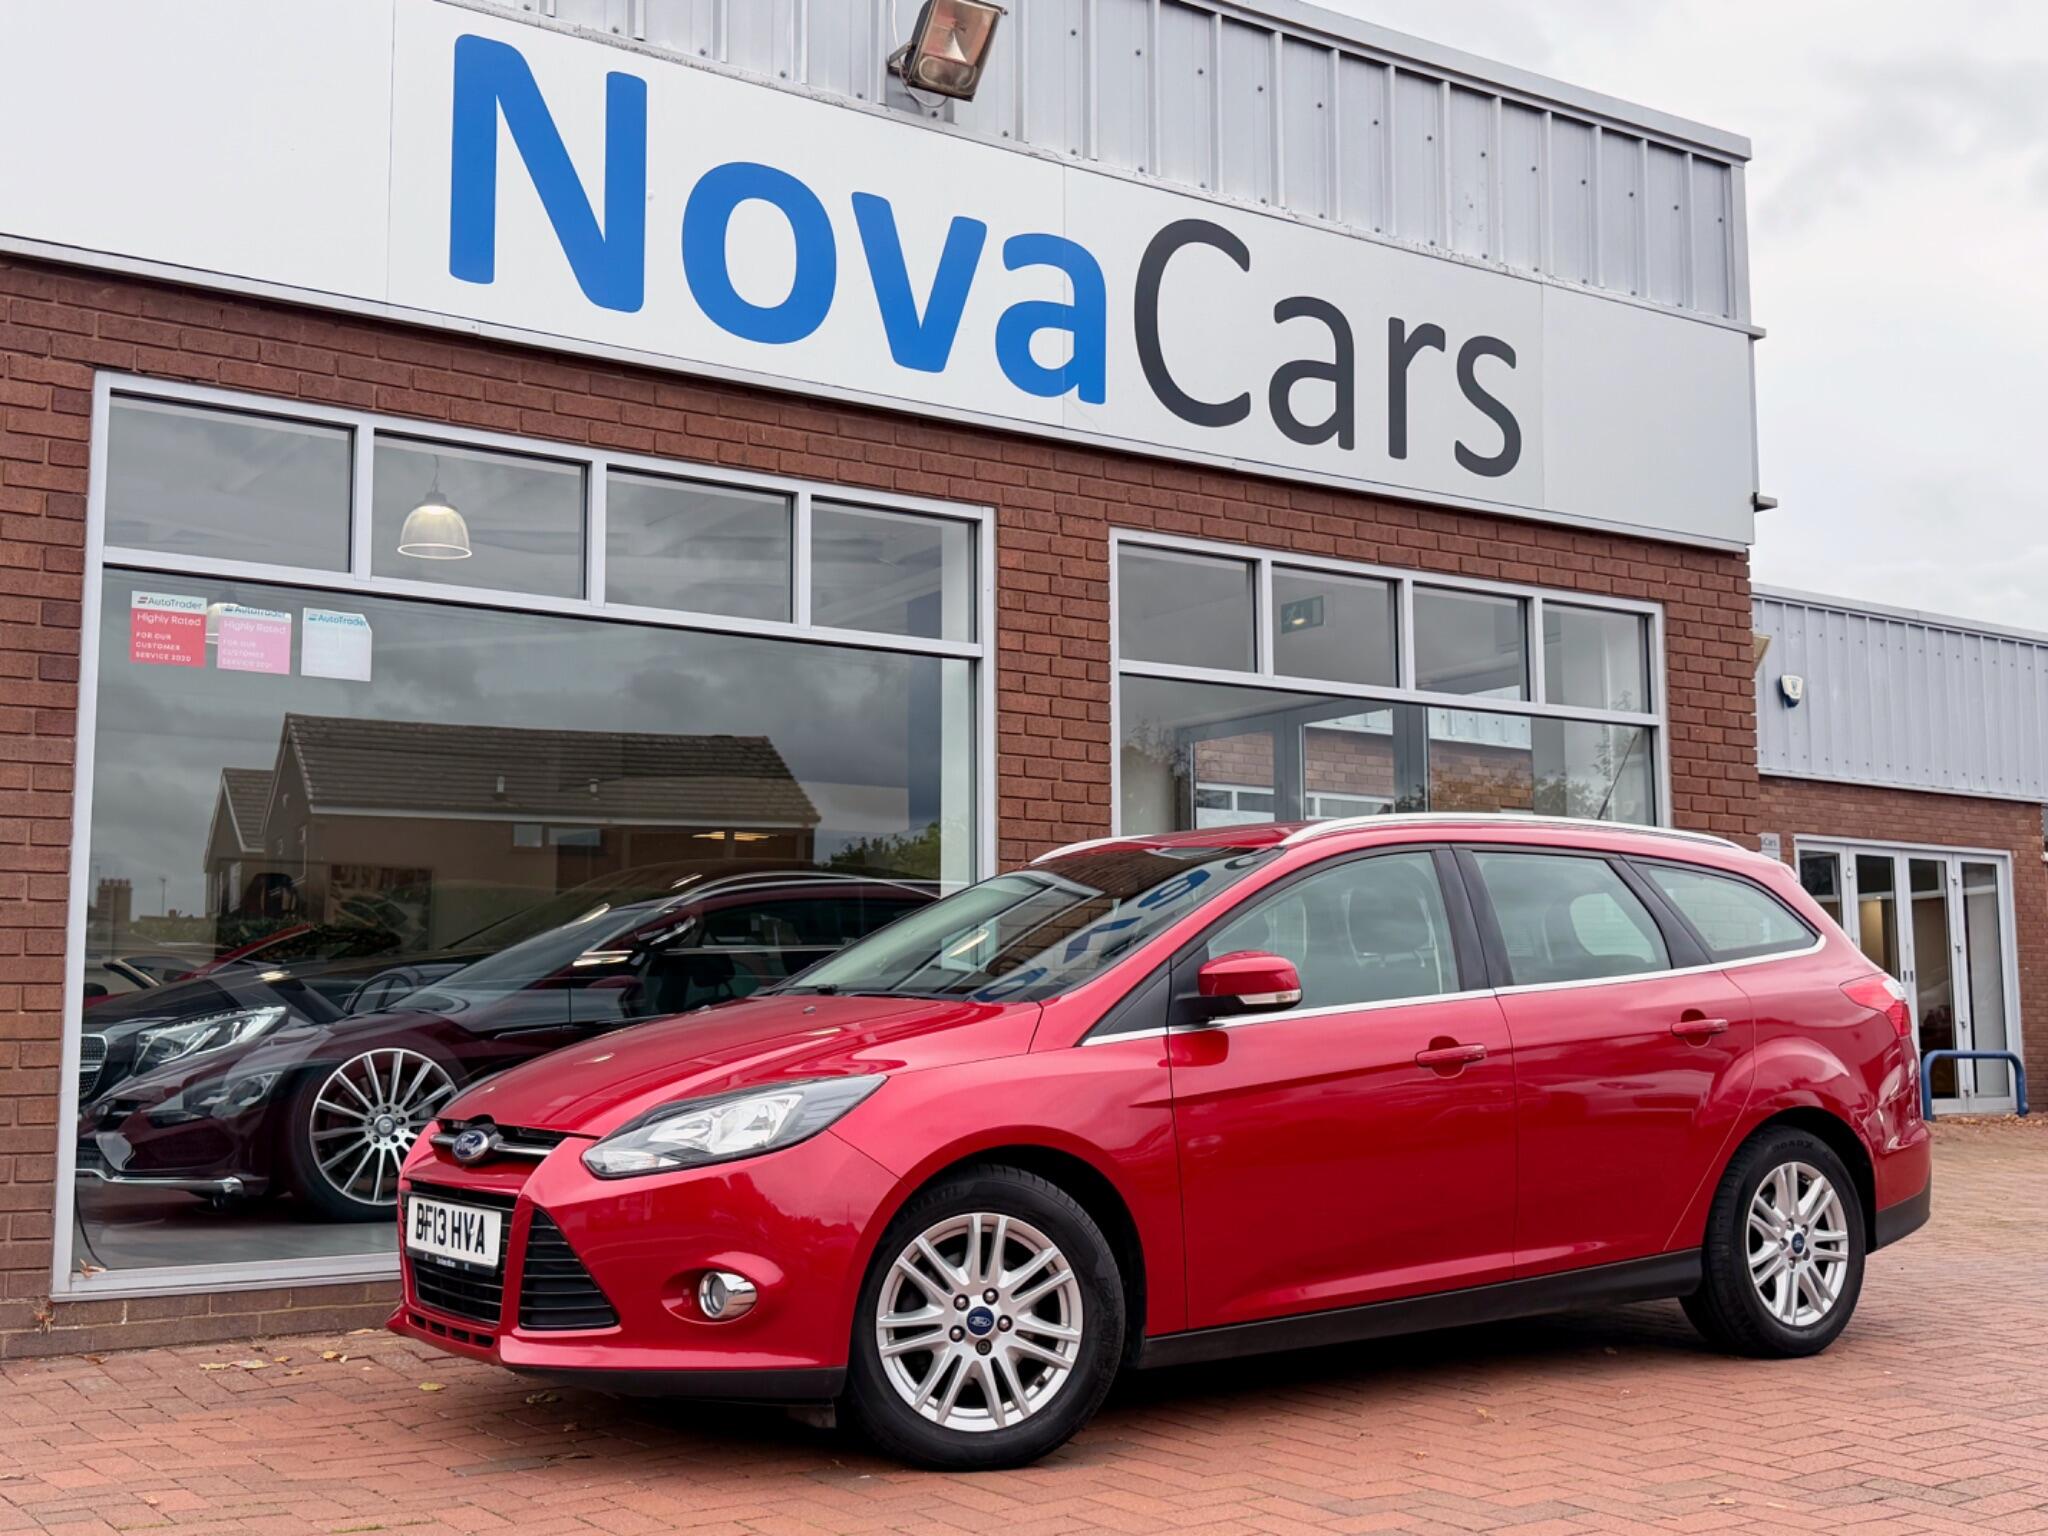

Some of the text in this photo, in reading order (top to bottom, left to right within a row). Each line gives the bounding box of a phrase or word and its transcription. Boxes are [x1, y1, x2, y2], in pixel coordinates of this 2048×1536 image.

[448, 33, 1523, 479] NovaCars
[148, 596, 203, 609] AutoTrader
[136, 612, 202, 627] Highly Rated
[223, 620, 287, 635] Highly Rated
[136, 631, 172, 641] FOR OUR
[135, 641, 181, 652] CUSTOMER
[135, 651, 169, 661] SERVICE
[415, 1202, 485, 1255] BF13 HVA
